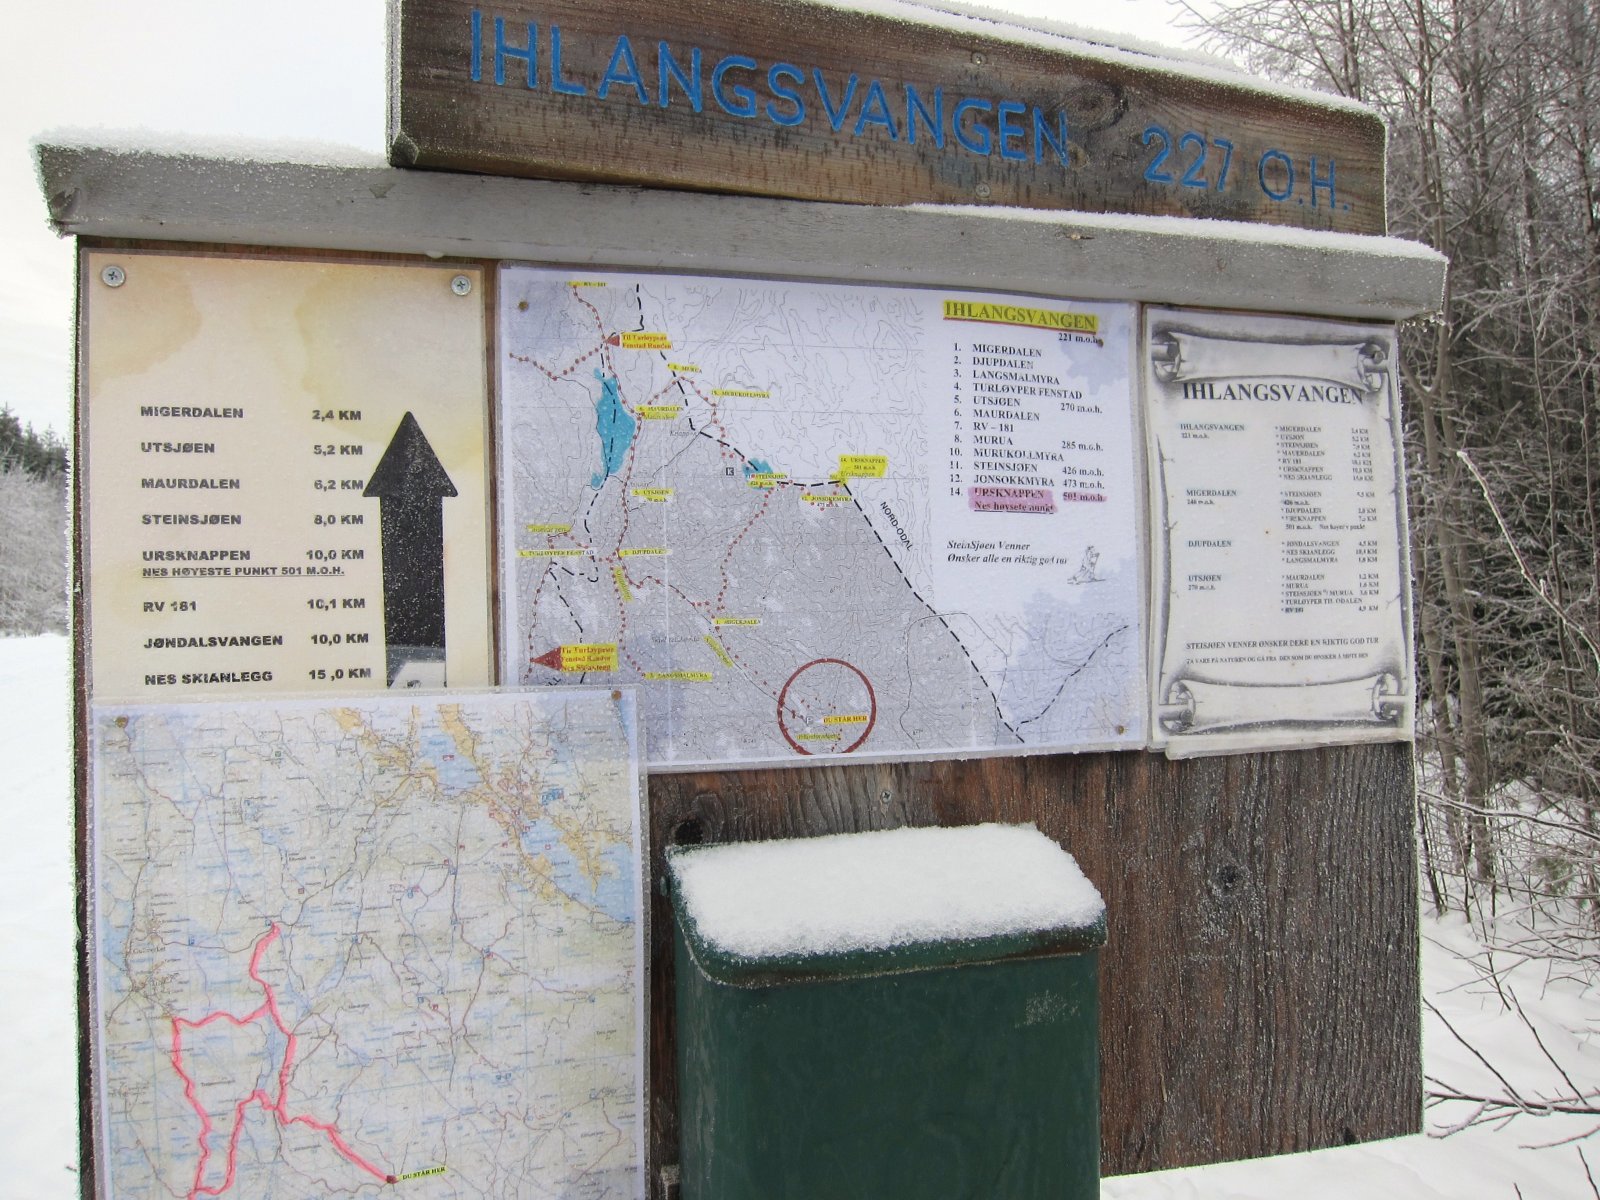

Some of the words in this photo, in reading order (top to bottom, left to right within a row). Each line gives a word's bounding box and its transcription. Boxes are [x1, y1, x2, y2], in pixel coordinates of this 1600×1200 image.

[471, 9, 1070, 168] IHLANGSVANGEN
[1142, 125, 1235, 192] 227
[1257, 148, 1350, 211] O.H.
[945, 301, 1096, 330] IHLANGSVANGEN
[1058, 332, 1072, 342] 221
[953, 342, 962, 352] 1.
[972, 343, 1042, 357] MIGERDALEN
[953, 355, 962, 365] 2.
[972, 357, 1034, 369] DJUPDALEN
[953, 369, 962, 378] 3.
[953, 382, 962, 391] 4.
[973, 382, 1036, 396] TURLØYPER
[1038, 385, 1083, 399] FENSTAD
[1182, 382, 1363, 405] IHLANGSVANGEN
[953, 395, 962, 404] 5.
[973, 395, 1021, 407] UTSJØEN
[1060, 402, 1075, 412] 270
[1076, 403, 1103, 414] m.o.h.
[141, 406, 244, 419] MIGERDALEN
[312, 409, 336, 422] 2,4
[338, 410, 362, 421] KM
[953, 408, 962, 417] 6.
[973, 408, 1040, 421] MAURDALEN
[954, 421, 962, 430] 7.
[973, 422, 989, 431] RV
[999, 423, 1014, 433] 181
[1179, 423, 1245, 432] IHLANGSVANGEN
[141, 442, 215, 454] UTSJØEN
[313, 444, 337, 456] 5,2
[339, 445, 363, 455] KM
[954, 434, 962, 443] 8.
[973, 435, 1013, 446] MURUA
[1061, 440, 1076, 450] 285
[1078, 442, 1104, 452] m.o.h.
[949, 447, 963, 457] 10.
[949, 461, 963, 470] 11.
[973, 461, 1038, 473] STEINSJØEN
[1062, 466, 1077, 475] 426
[1079, 467, 1105, 477] m.o.h.
[141, 478, 240, 490] MAURDALEN
[314, 479, 337, 491] 6,2
[340, 479, 363, 490] KM
[949, 474, 963, 483] 12.
[973, 474, 1055, 487] JONSOKKMYRA
[1062, 478, 1077, 488] 473
[1079, 480, 1105, 490] m.o.h.
[949, 487, 963, 497] 14.
[973, 488, 1045, 499] URSKNAPPEN
[1063, 491, 1077, 501] 501
[1079, 493, 1105, 503] m.o.h.
[1186, 489, 1237, 497] MIGERDALEN
[142, 513, 242, 526] STEINSJØEN
[314, 514, 337, 526] 8,0
[340, 514, 363, 525] KM
[880, 501, 913, 551] NORD-ODAL
[998, 541, 1030, 551] Venner
[1187, 540, 1232, 548] DJUPDALEN
[142, 550, 251, 561] URSKNAPPEN
[306, 549, 338, 561] 10,0
[340, 549, 364, 560] KM
[946, 553, 980, 563] Ønsker
[982, 554, 999, 563] alle
[142, 567, 170, 577] NES
[172, 567, 231, 576] HØYESTE
[234, 567, 278, 576] PUNKT
[281, 566, 303, 576] 501
[306, 566, 345, 576] M.O.H.
[1187, 574, 1222, 582] UTSJØEN
[143, 601, 165, 612] RV
[170, 601, 197, 612] 181
[307, 598, 338, 610] 10,1
[342, 598, 365, 609] KM
[143, 634, 283, 649] JØNDALSVANGEN
[310, 634, 342, 646] 10,0
[346, 633, 369, 644] KM
[1227, 640, 1257, 648] VENNER
[1258, 639, 1288, 648] ØNSKER
[1349, 637, 1365, 645] GOD
[1366, 636, 1379, 644] TUR
[145, 673, 177, 686] NES
[181, 671, 273, 685] SKIANLEGG
[348, 667, 372, 679] KM
[412, 1169, 431, 1178] STÅR
[431, 1166, 446, 1175] HER
